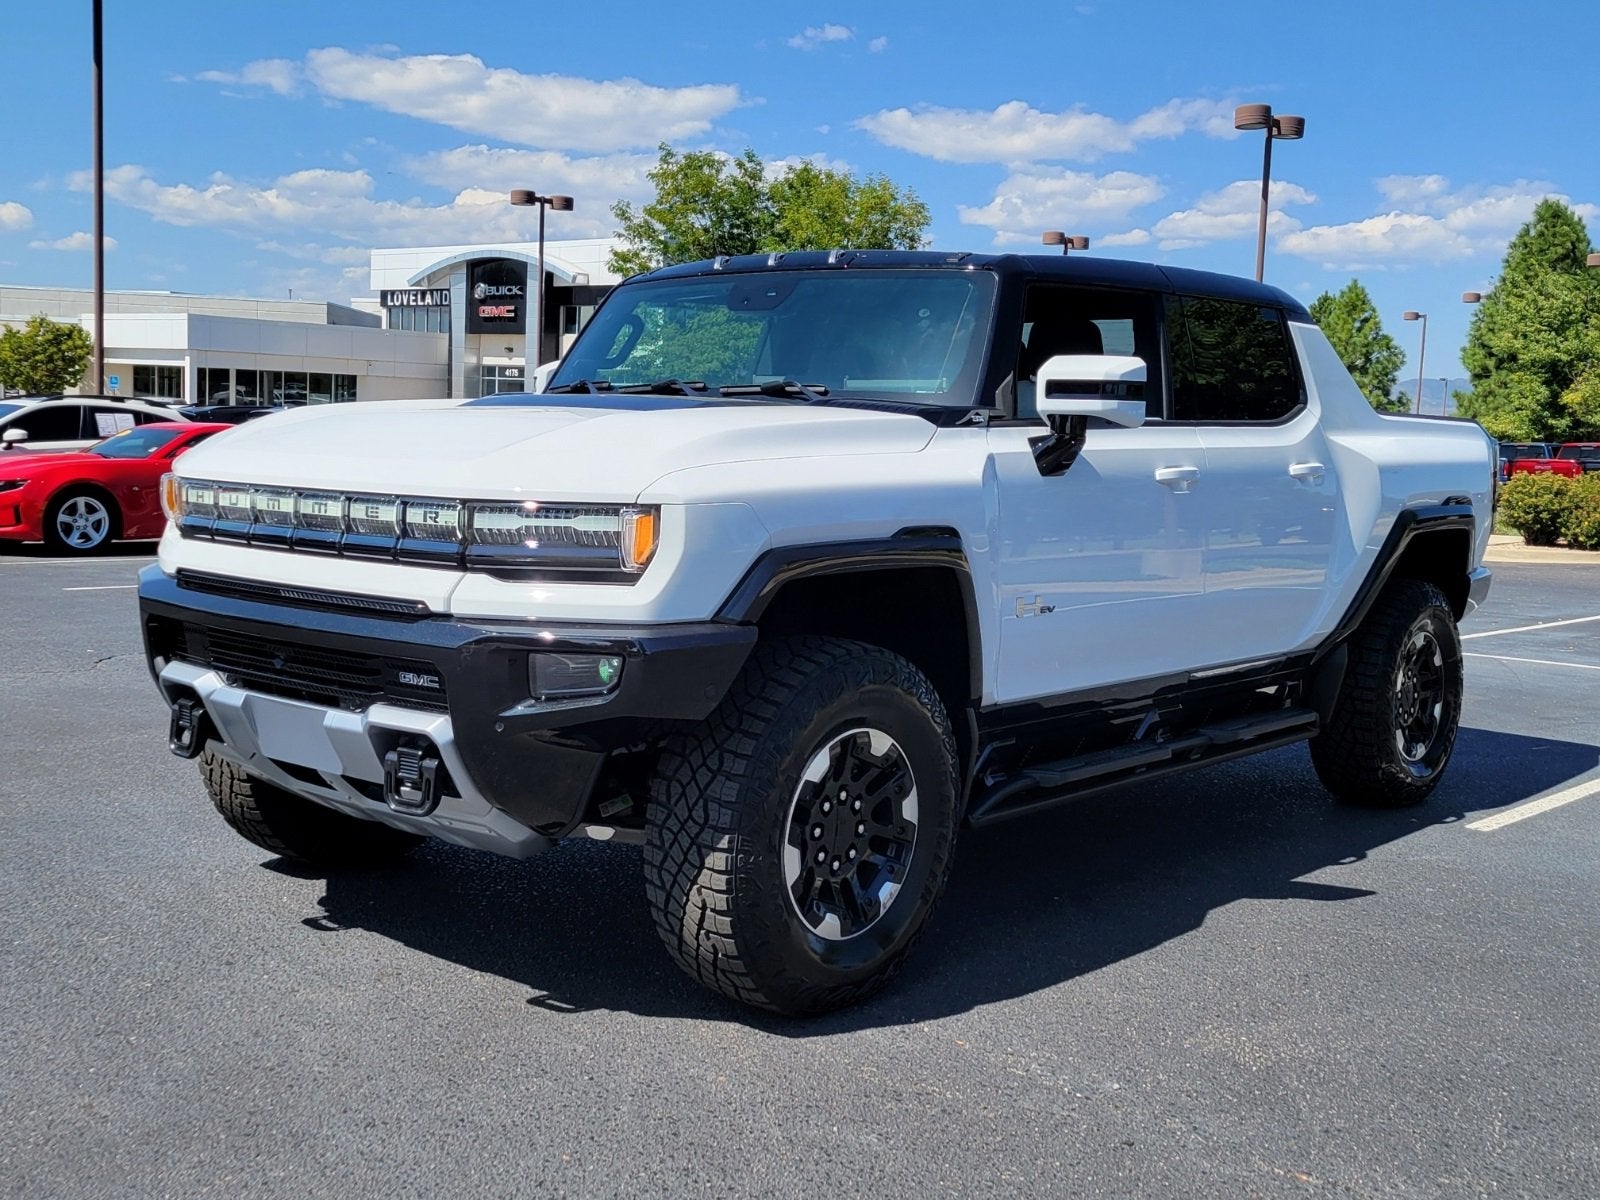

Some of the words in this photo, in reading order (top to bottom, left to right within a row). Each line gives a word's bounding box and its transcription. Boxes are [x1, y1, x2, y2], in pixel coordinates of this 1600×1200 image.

[485, 285, 523, 296] BUICK
[387, 290, 450, 306] LOVELAND
[479, 305, 515, 317] GMC
[504, 368, 519, 377] 4175
[196, 490, 440, 524] HUMMER
[399, 671, 440, 688] GMC
